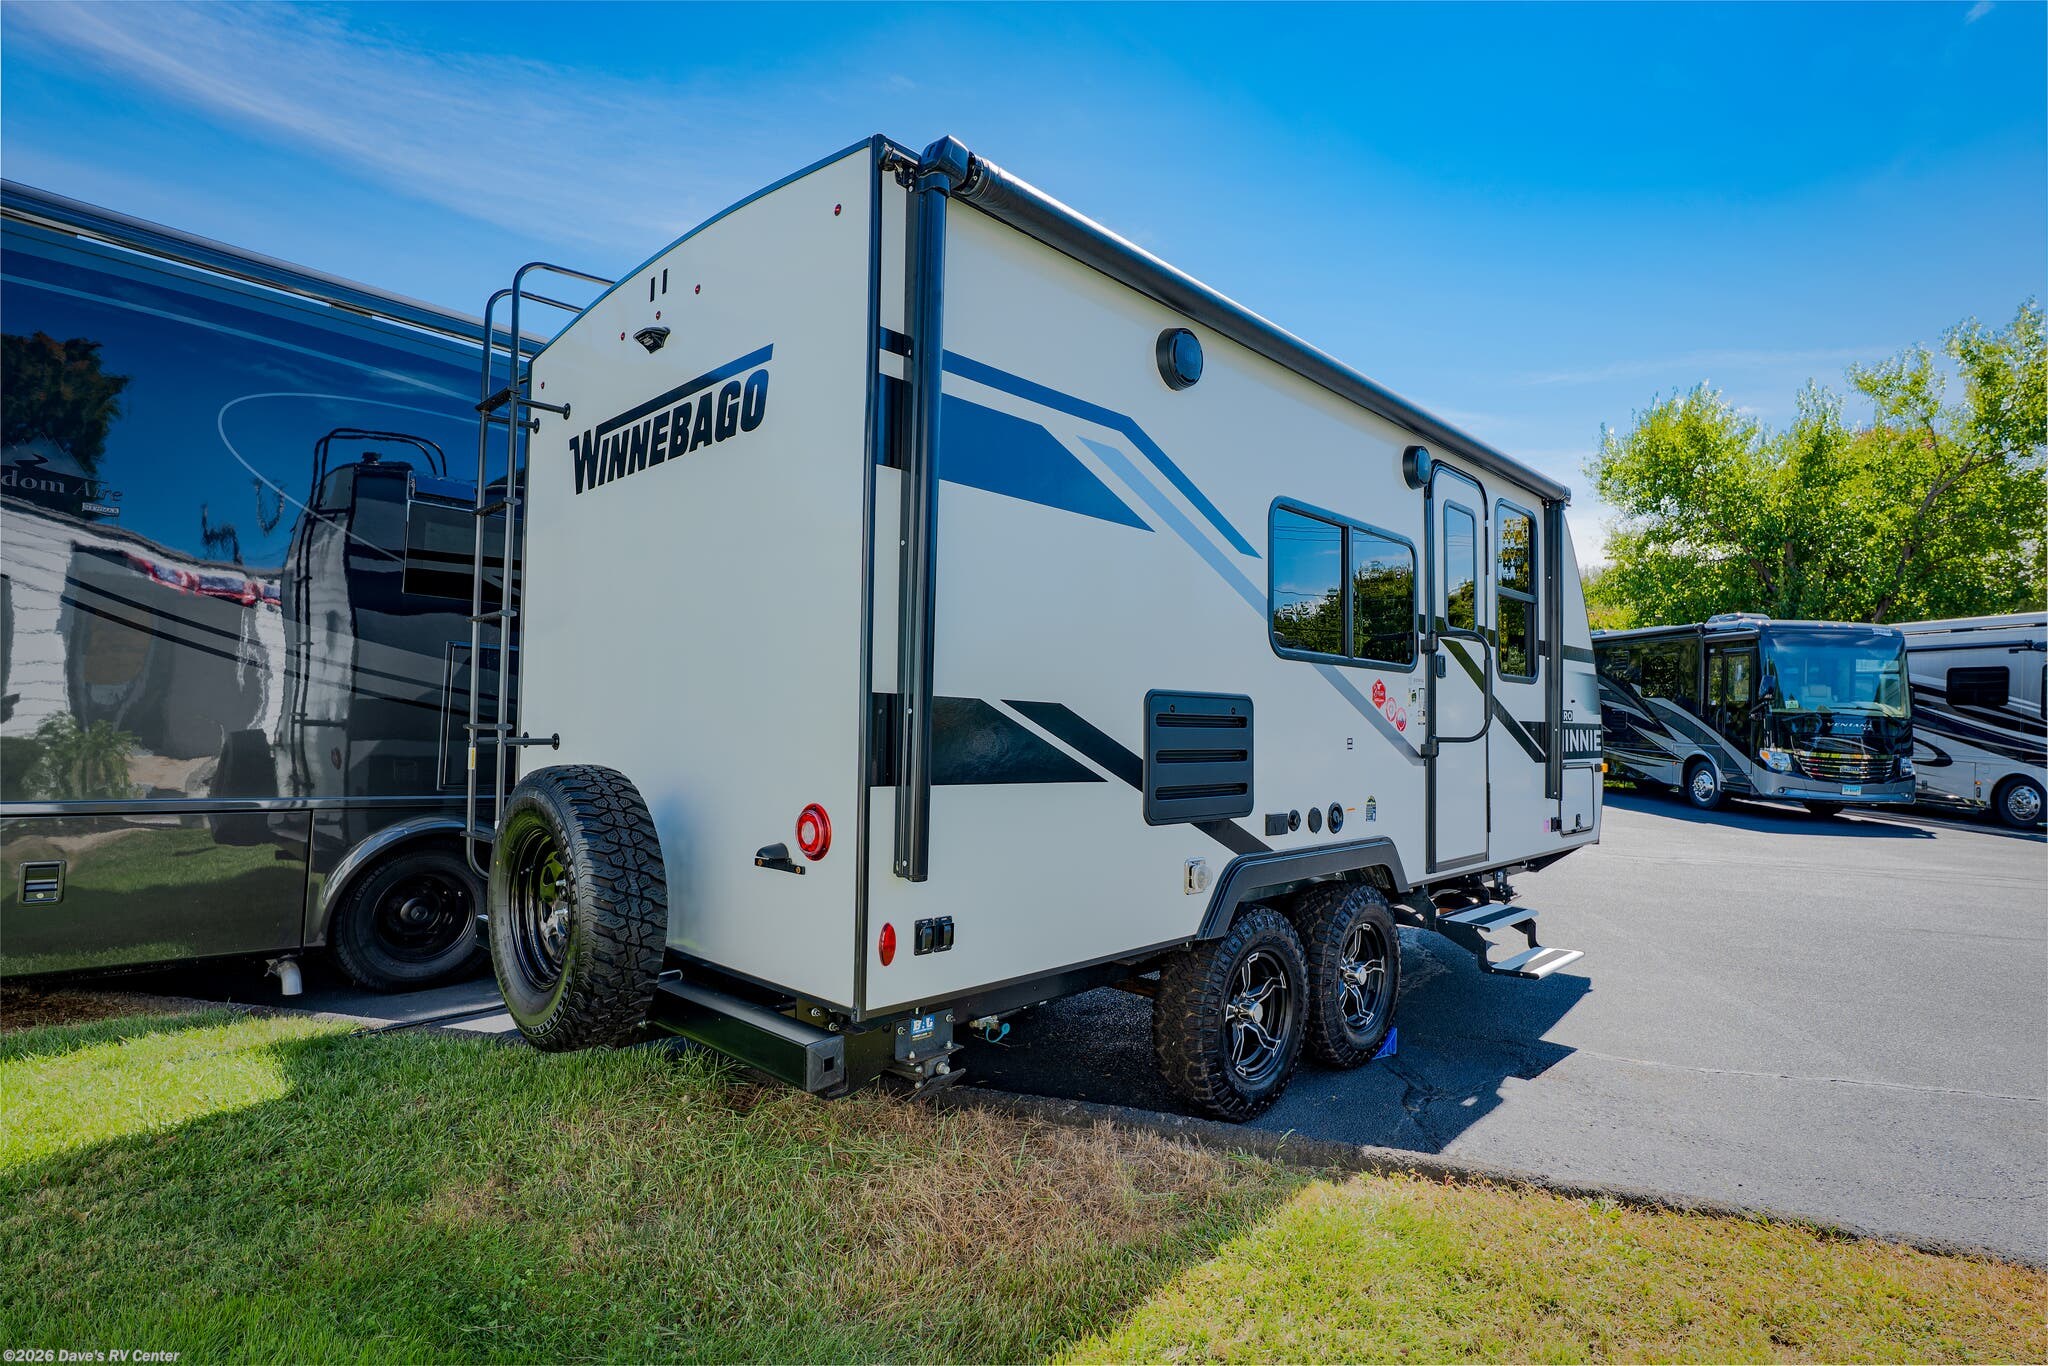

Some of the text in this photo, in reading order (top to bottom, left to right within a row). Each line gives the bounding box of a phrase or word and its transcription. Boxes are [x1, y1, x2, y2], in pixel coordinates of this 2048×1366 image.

[569, 368, 770, 496] WINNEBAGO
[72, 480, 123, 502] Aire
[1563, 729, 1602, 752] INNIE
